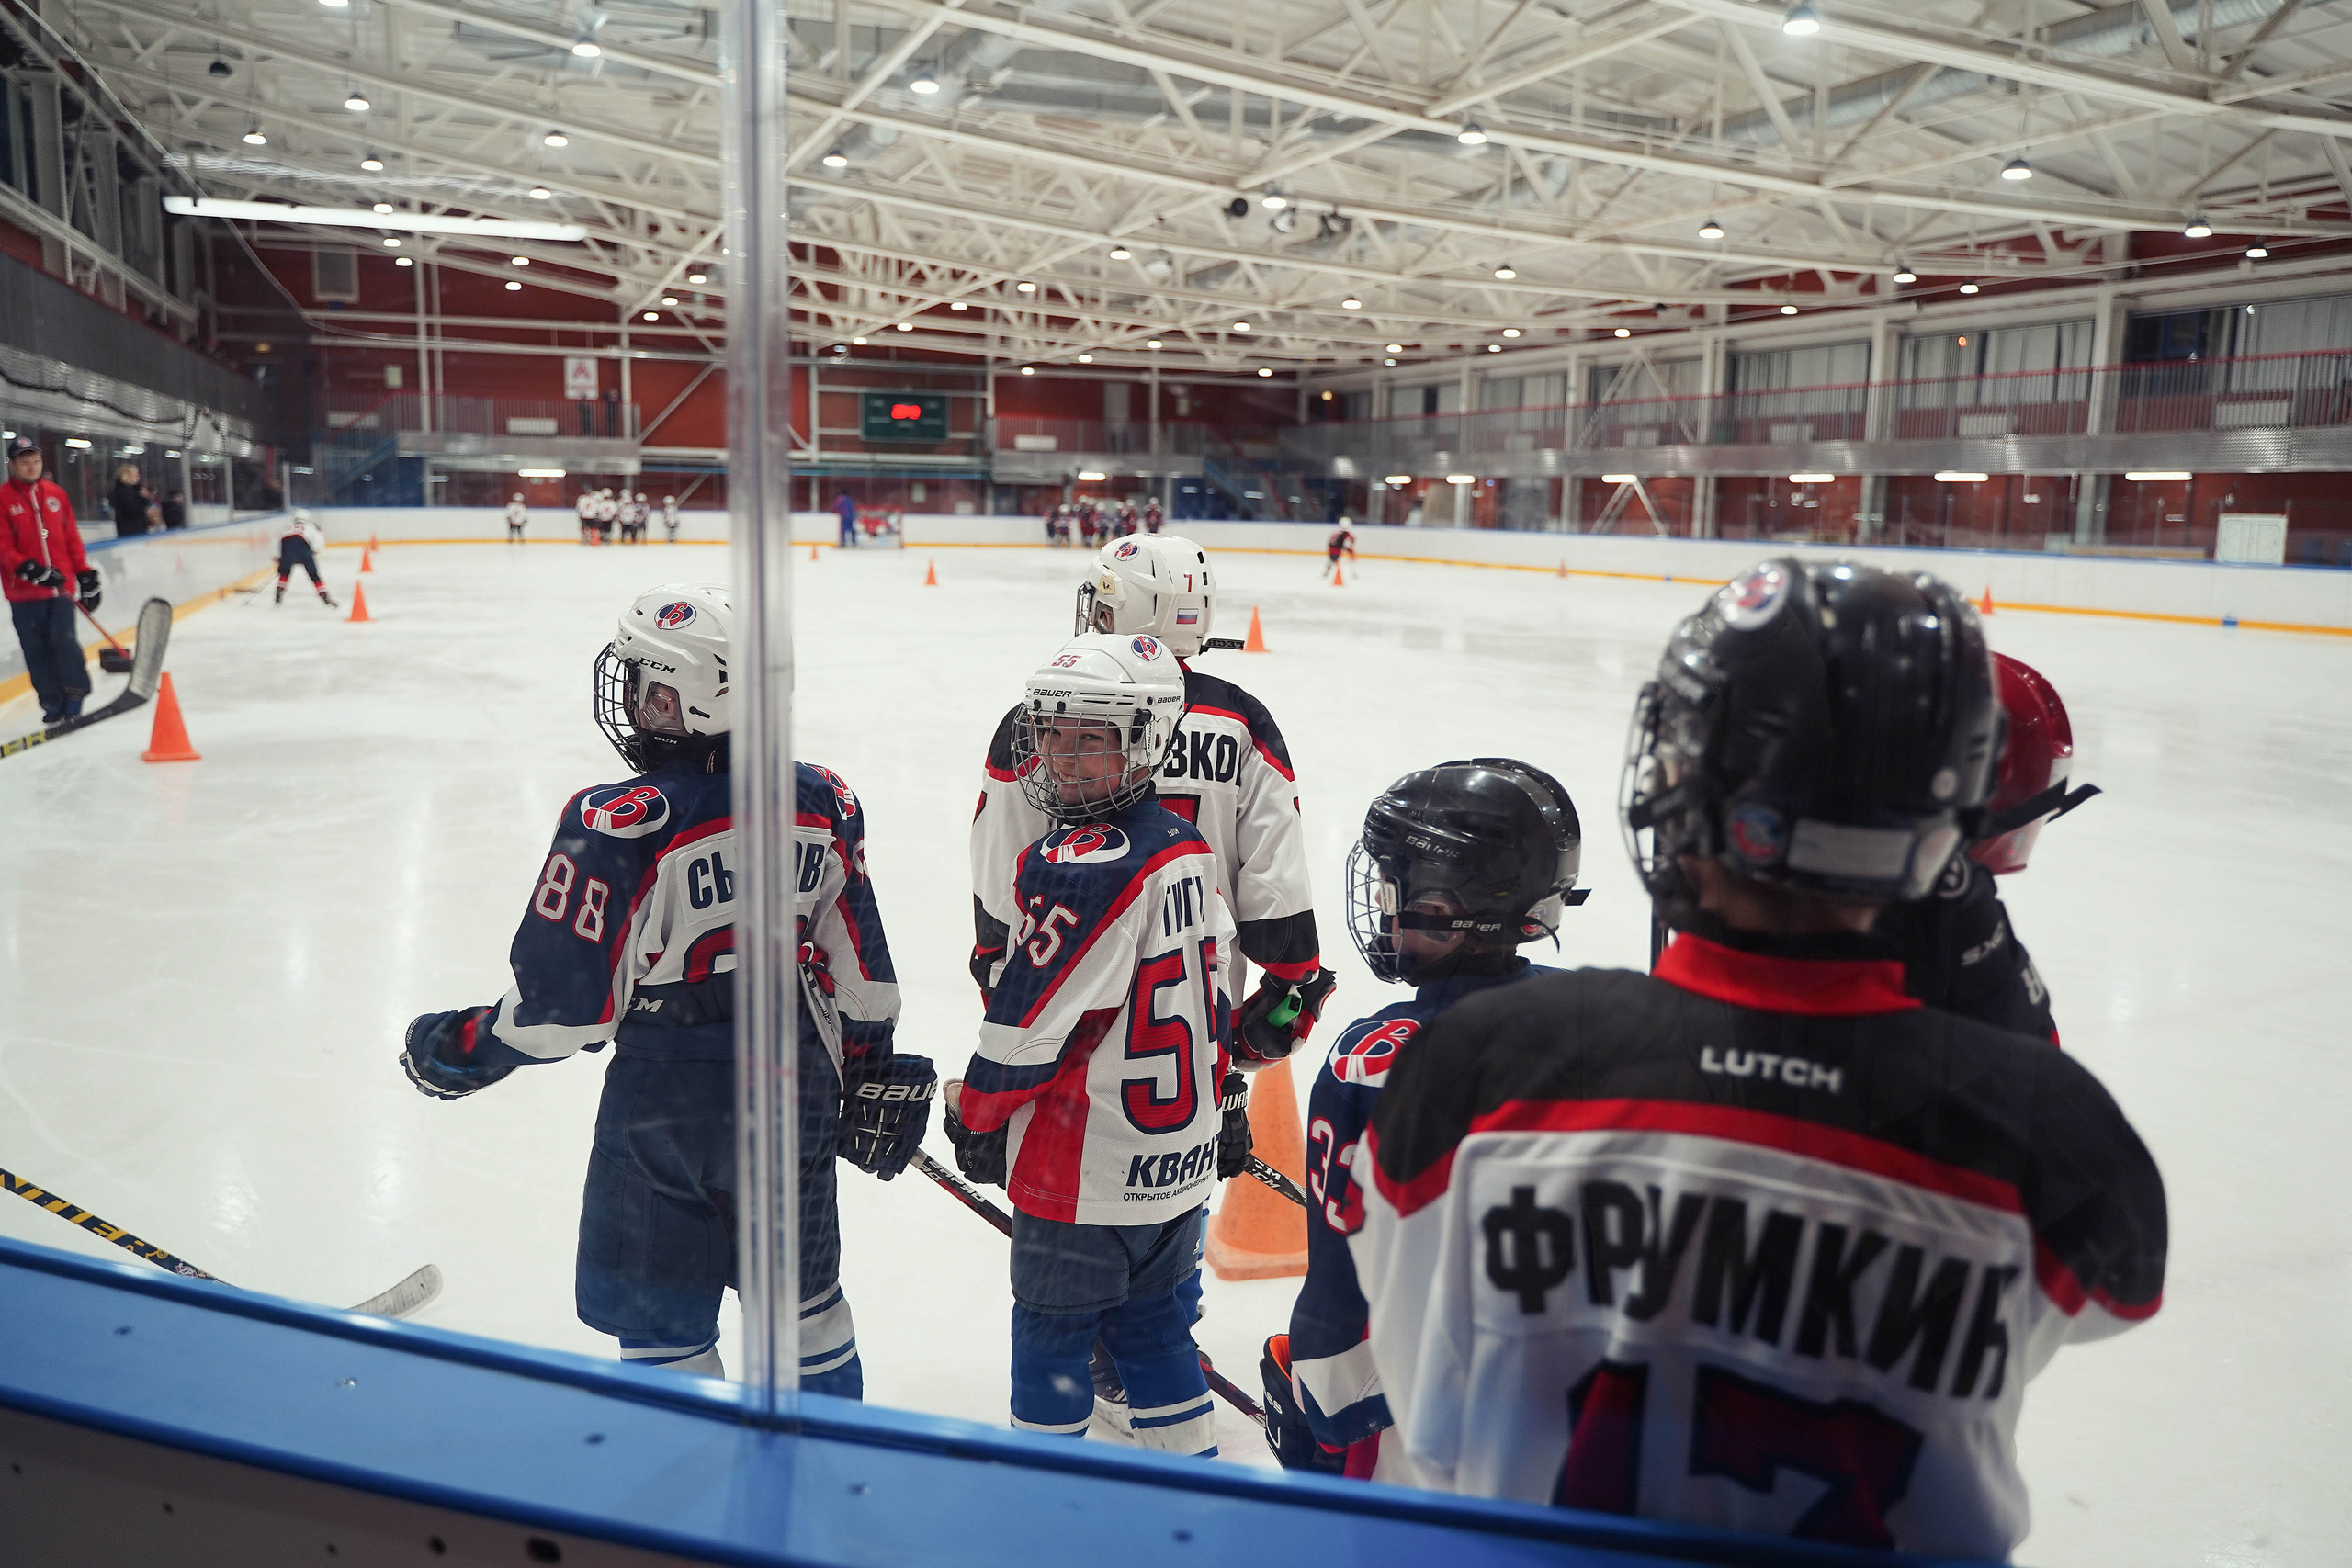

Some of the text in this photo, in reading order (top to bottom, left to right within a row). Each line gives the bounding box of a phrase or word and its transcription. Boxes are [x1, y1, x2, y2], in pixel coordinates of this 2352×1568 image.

[1183, 574, 1193, 592] 7
[639, 657, 677, 674] CCM
[1051, 654, 1082, 668] 55
[653, 736, 678, 745] CCM
[534, 851, 611, 944] 88
[1700, 1045, 1843, 1094] LUTCH
[1123, 1190, 1171, 1201] ОТКРЫТОЕ
